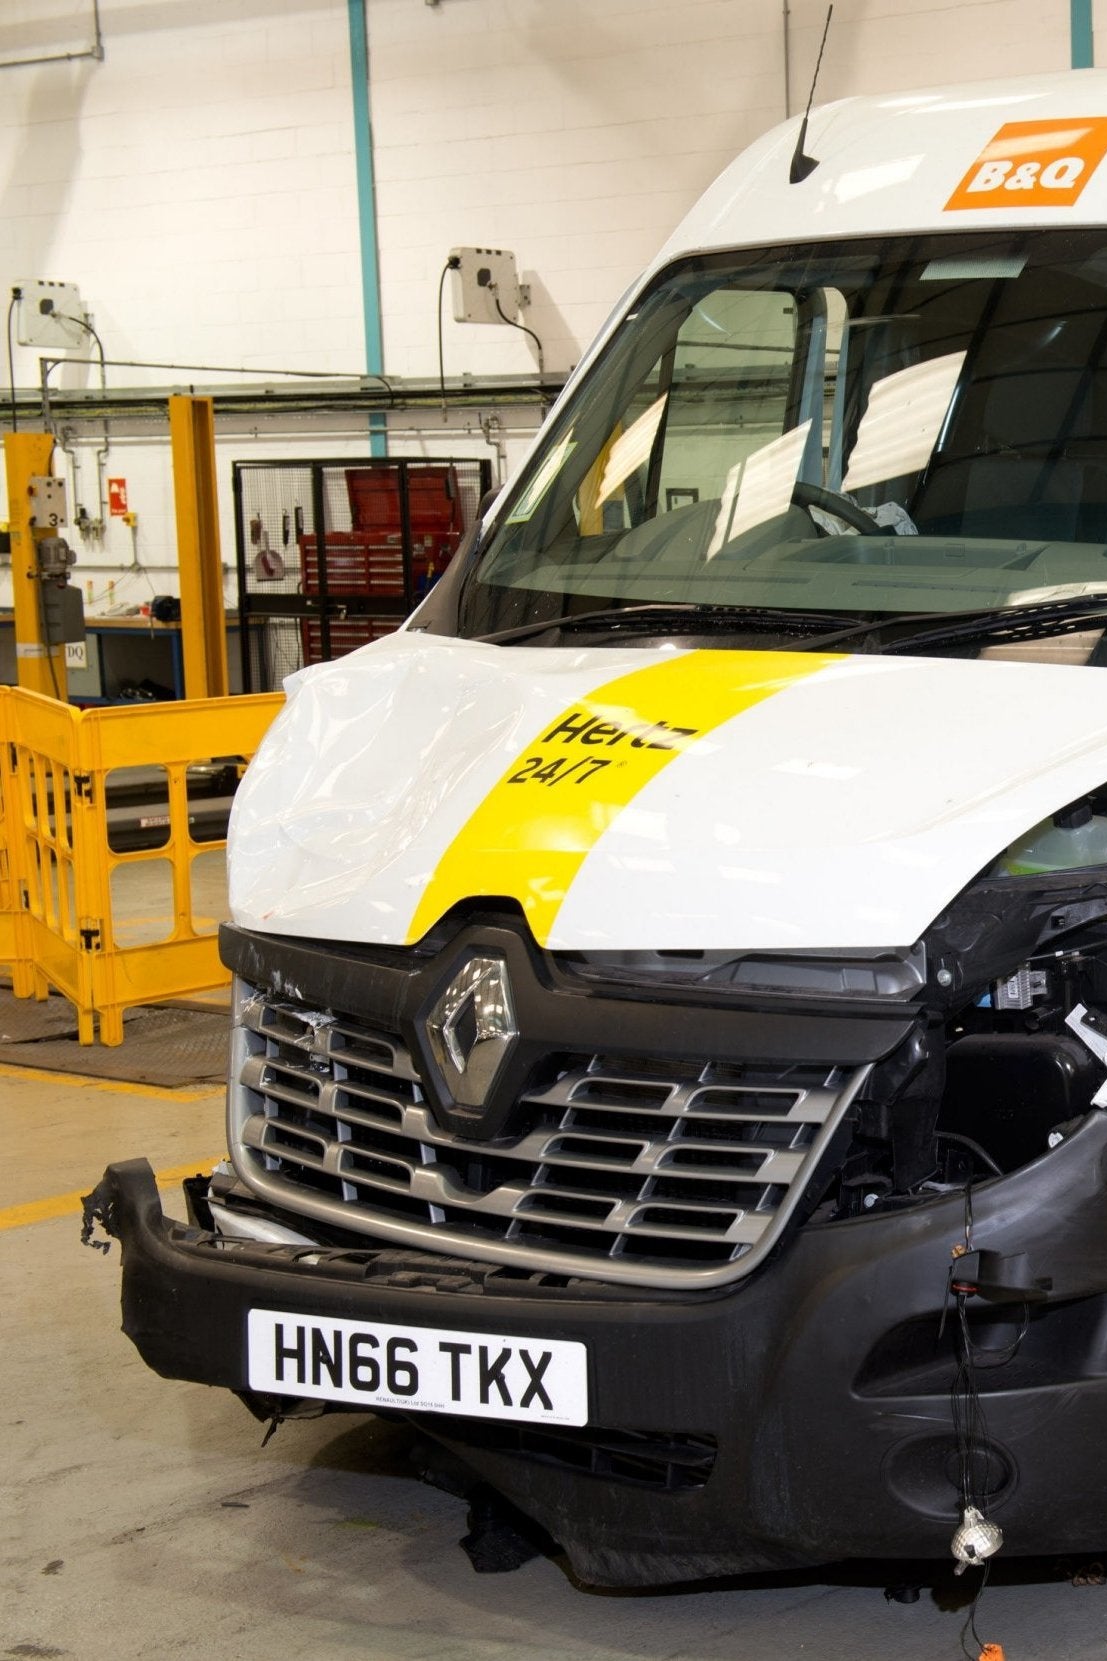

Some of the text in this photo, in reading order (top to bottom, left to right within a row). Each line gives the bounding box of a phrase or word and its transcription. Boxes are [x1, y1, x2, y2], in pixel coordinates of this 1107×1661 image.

[966, 157, 1085, 193] B&Q
[49, 513, 58, 527] 3
[541, 712, 699, 750] Hertz
[507, 756, 612, 787] 24/7
[275, 1323, 553, 1411] HN66 TKX
